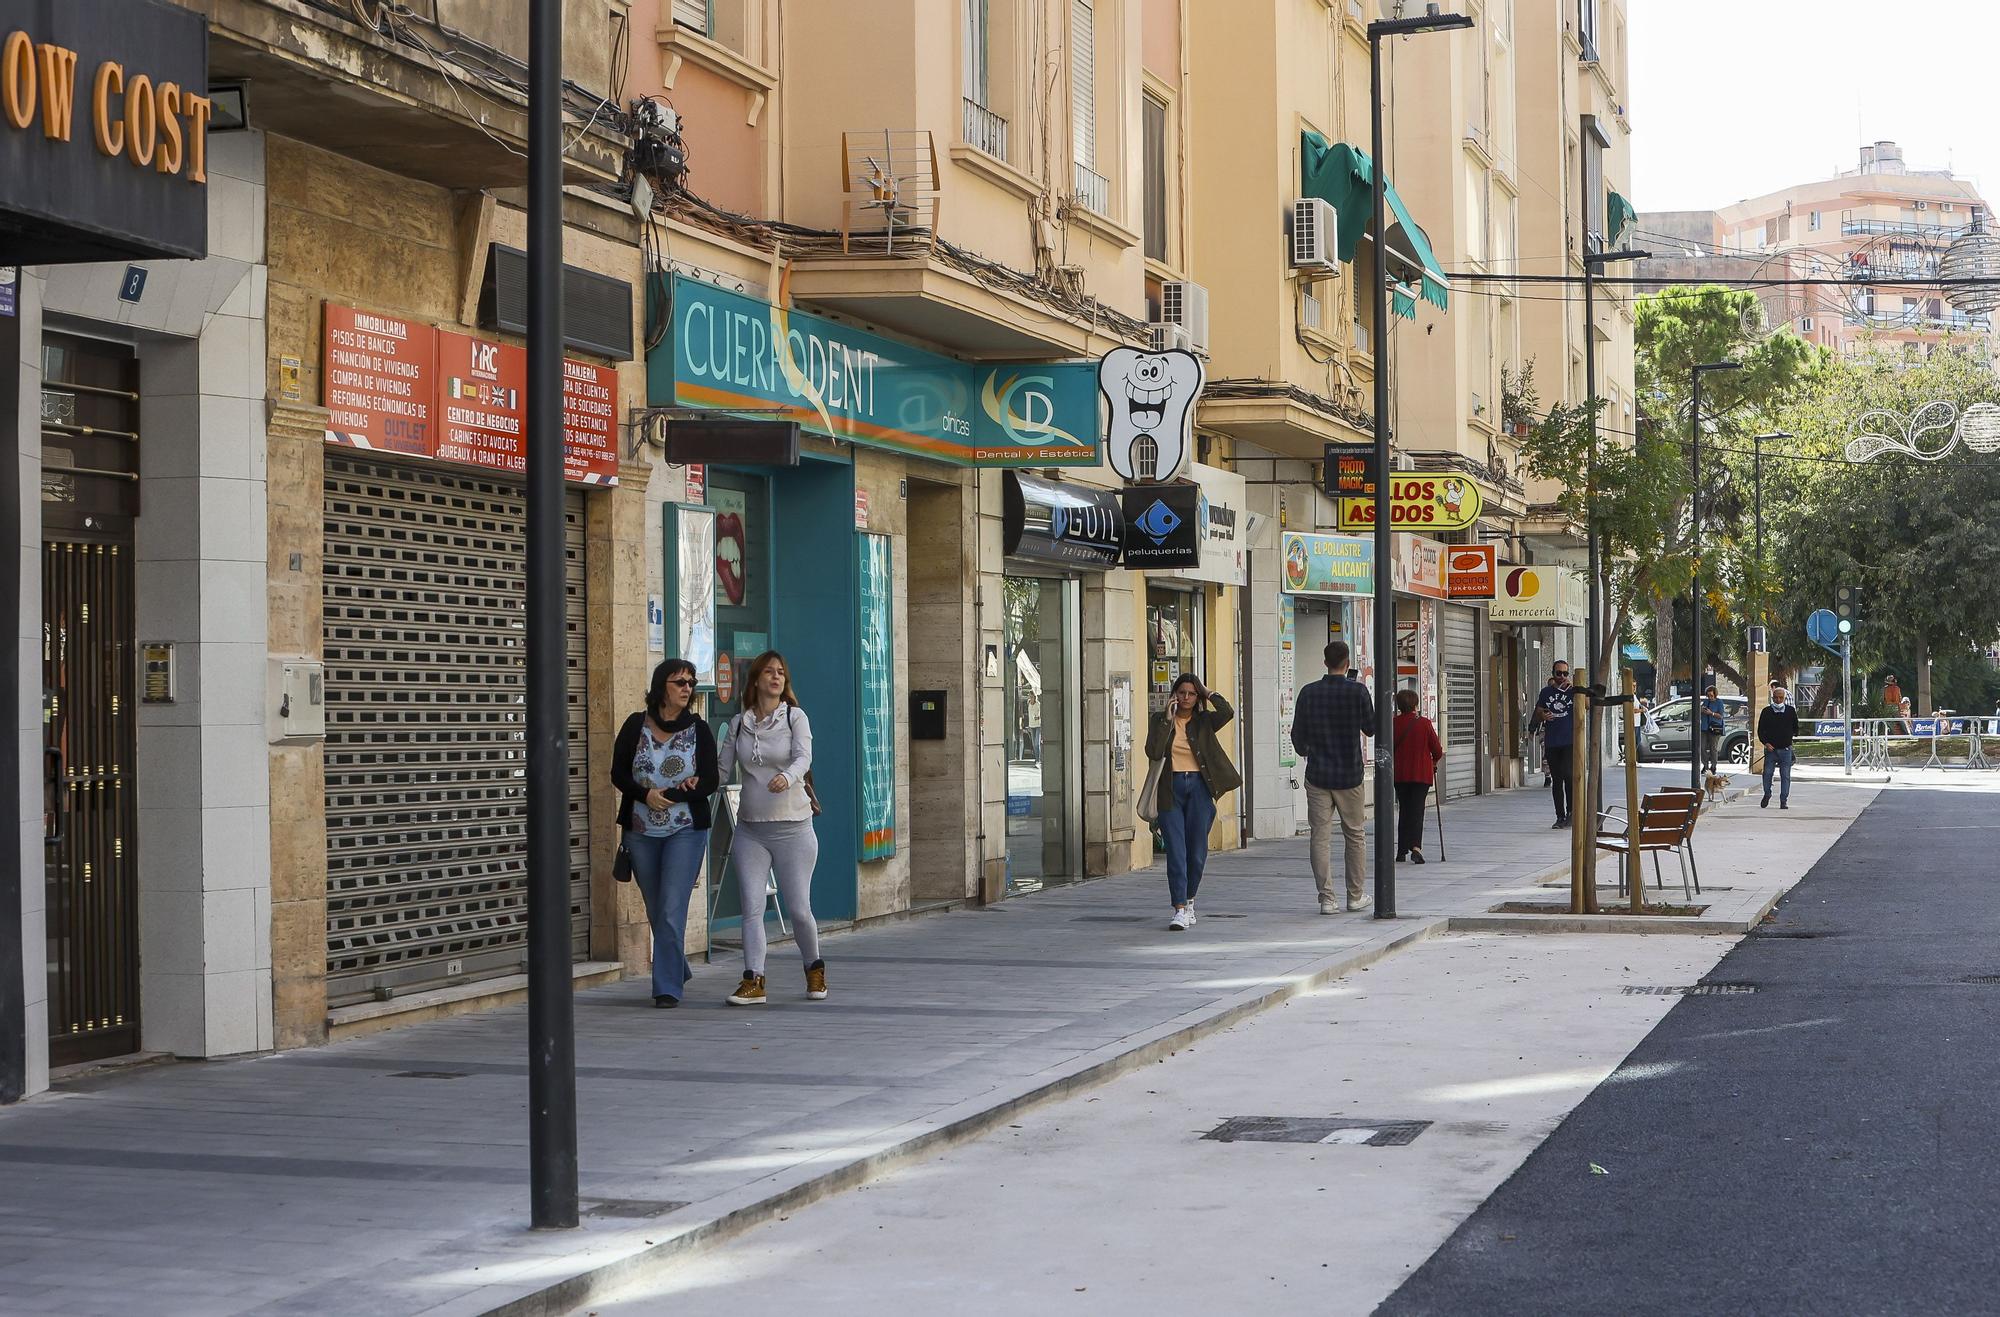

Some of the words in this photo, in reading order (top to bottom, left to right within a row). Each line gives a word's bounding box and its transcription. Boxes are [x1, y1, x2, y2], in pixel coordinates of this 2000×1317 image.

[94, 61, 210, 183] COST
[128, 274, 140, 295] 8
[354, 313, 407, 337] INMOBILIARIA
[332, 329, 354, 346] PISOS
[357, 334, 366, 349] DE
[367, 337, 396, 355] BANCOS
[471, 341, 498, 374] MRC
[684, 301, 879, 417] CUERPODENT
[373, 357, 382, 371] DE
[384, 359, 419, 379] VIVIENDAS
[563, 362, 597, 380] TRANJERÍA
[332, 369, 362, 388] COMPRA
[364, 376, 374, 390] DE
[375, 377, 411, 397] VIVIENDAS
[574, 381, 582, 395] DE
[583, 384, 609, 400] CUENTAS
[332, 389, 371, 410] REFORMAS
[418, 404, 427, 419] DE
[569, 397, 577, 410] DE
[578, 399, 612, 417] SOCIEDADES
[330, 410, 368, 429] VIVIENDAS
[447, 406, 474, 424] CENTRO
[476, 412, 485, 426] DE
[486, 414, 519, 432] NEGOCIOS
[571, 414, 579, 427] DE
[580, 415, 608, 432] ESTANCIA
[942, 410, 970, 437] clínicas
[384, 418, 426, 441] OUTLET
[450, 428, 481, 446] CABINETS
[575, 431, 606, 448] BANCARIOS
[440, 444, 471, 460] BUREAUX
[473, 449, 477, 461] A
[478, 450, 496, 465] ORAN
[497, 453, 505, 467] ET
[506, 454, 526, 470] ALGER
[976, 450, 1021, 459] Dental
[1027, 451, 1034, 460] y
[1039, 449, 1095, 459] Estética
[1339, 460, 1365, 474] PHOTO
[1338, 476, 1364, 489] MAGIC
[1349, 504, 1435, 522] ASDOS
[1128, 546, 1193, 557] peluquerías
[1322, 541, 1361, 557] POLLASTRE
[1448, 576, 1489, 585] cocinas
[1490, 604, 1504, 617] La
[1509, 606, 1555, 617] mercería
